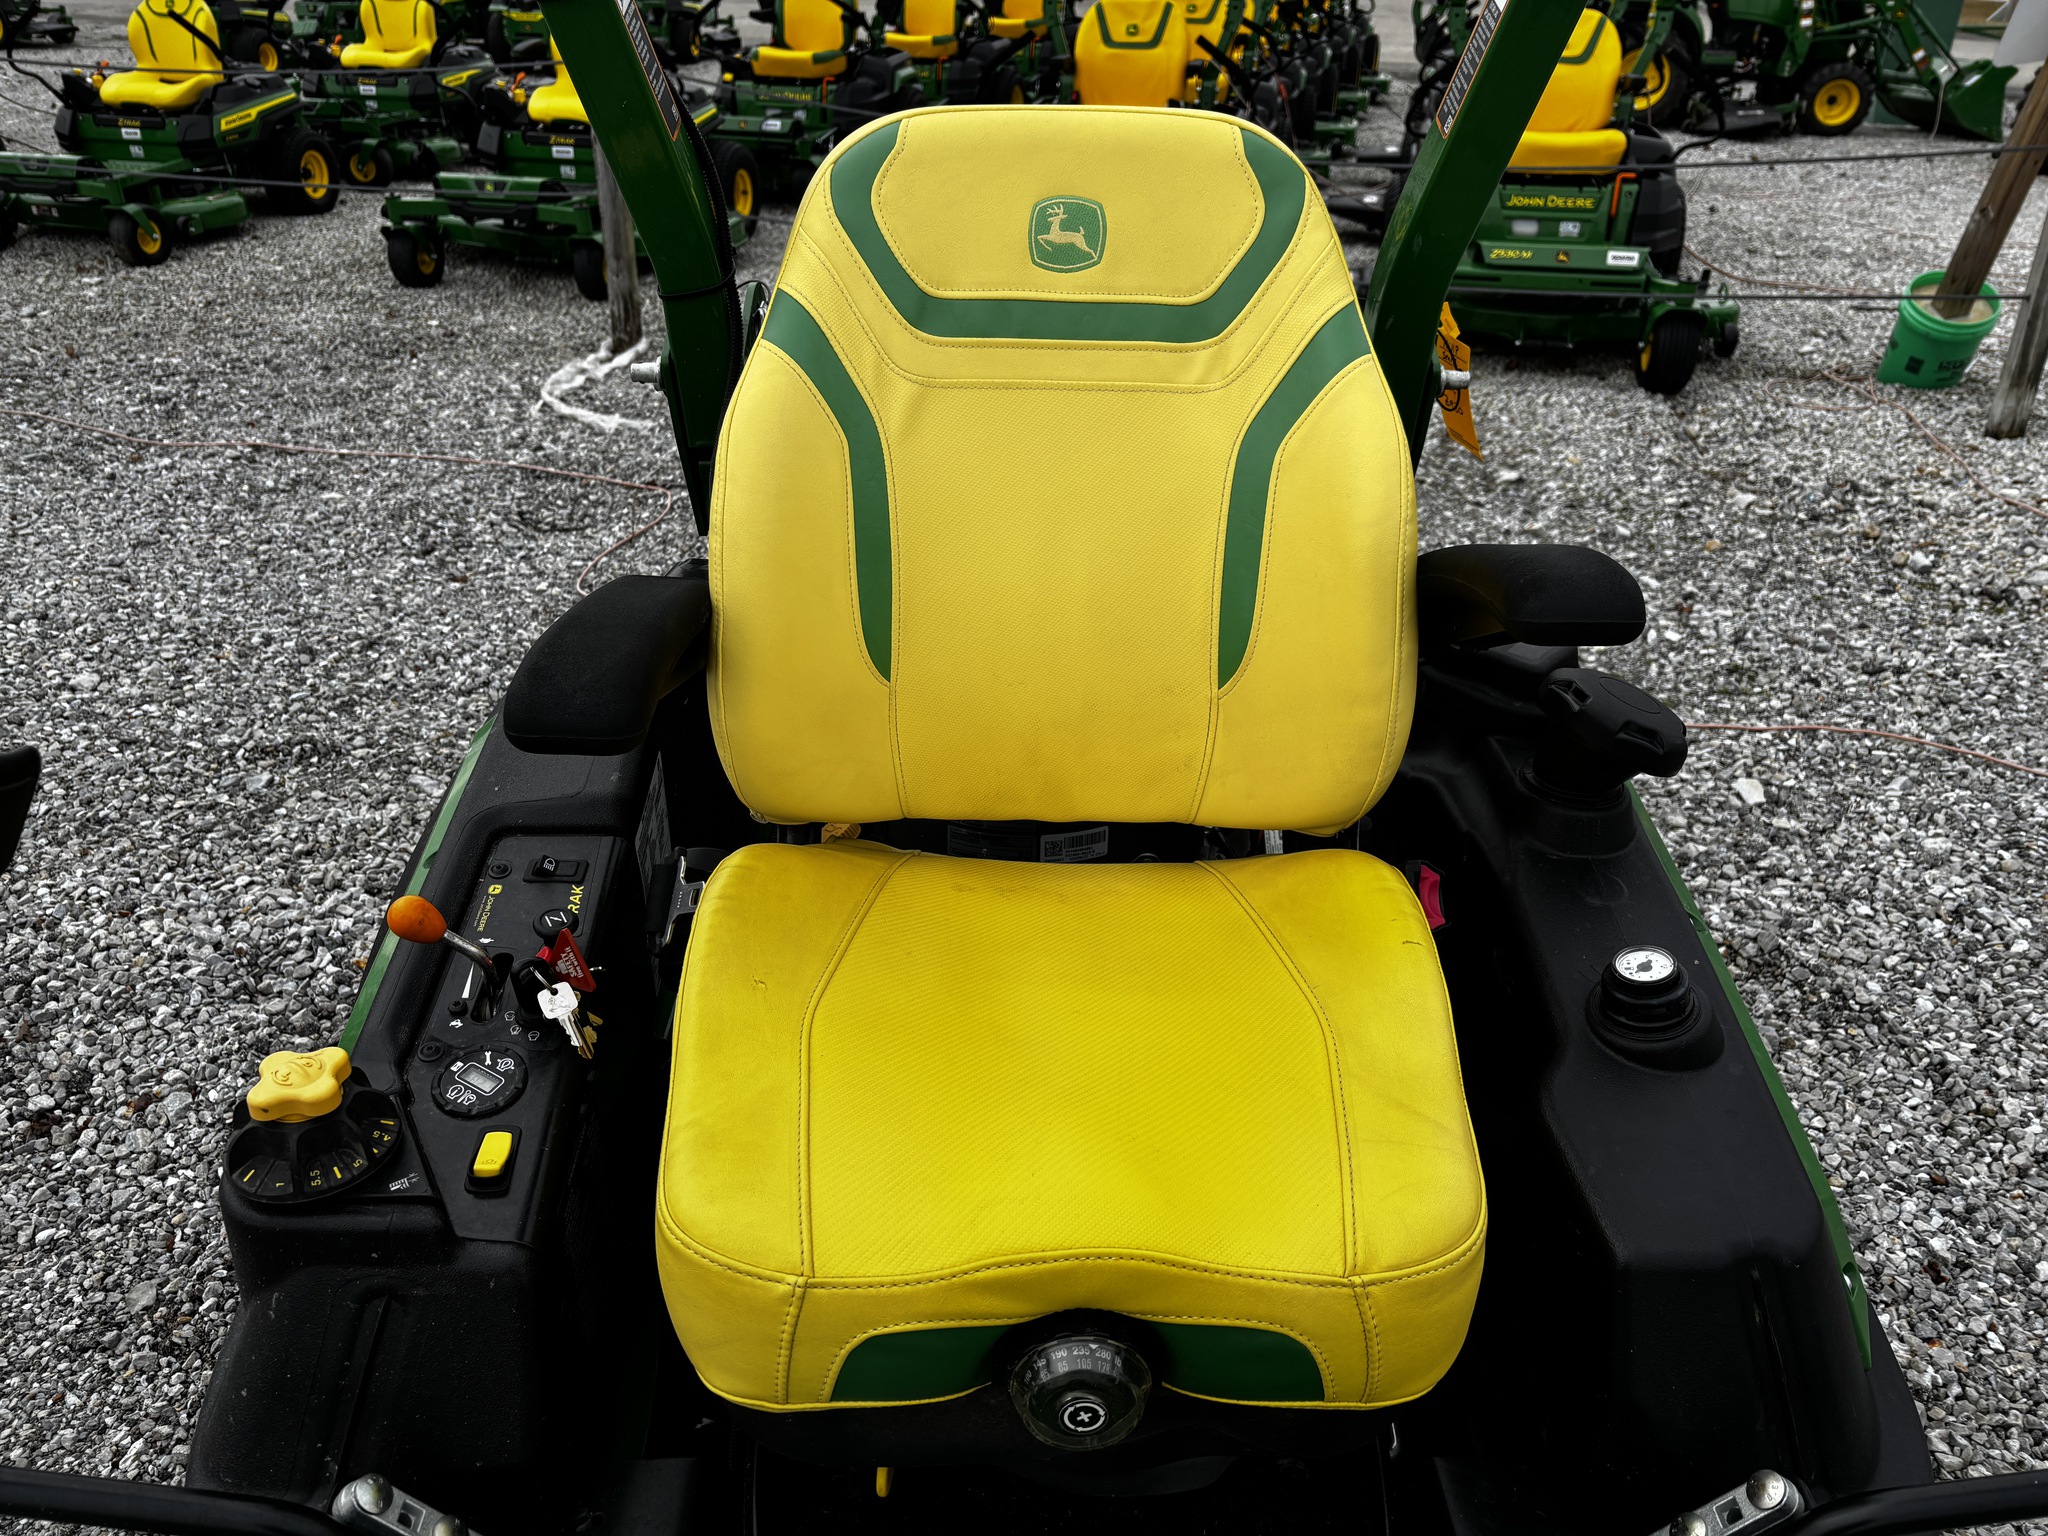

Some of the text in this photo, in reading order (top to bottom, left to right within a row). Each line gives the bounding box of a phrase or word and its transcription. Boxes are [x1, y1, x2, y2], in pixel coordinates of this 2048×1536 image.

[1506, 194, 1595, 209] JOHN DEERE
[484, 895, 496, 912] JOHN
[477, 911, 491, 932] DEERE
[560, 953, 577, 978] SAFETY
[310, 1169, 322, 1186] 5.5
[1033, 1355, 1047, 1370] 145
[1050, 1347, 1068, 1360] 190
[1072, 1345, 1090, 1355] 235
[1095, 1347, 1112, 1360] 280
[1058, 1360, 1069, 1373] 85
[1077, 1358, 1092, 1370] 105
